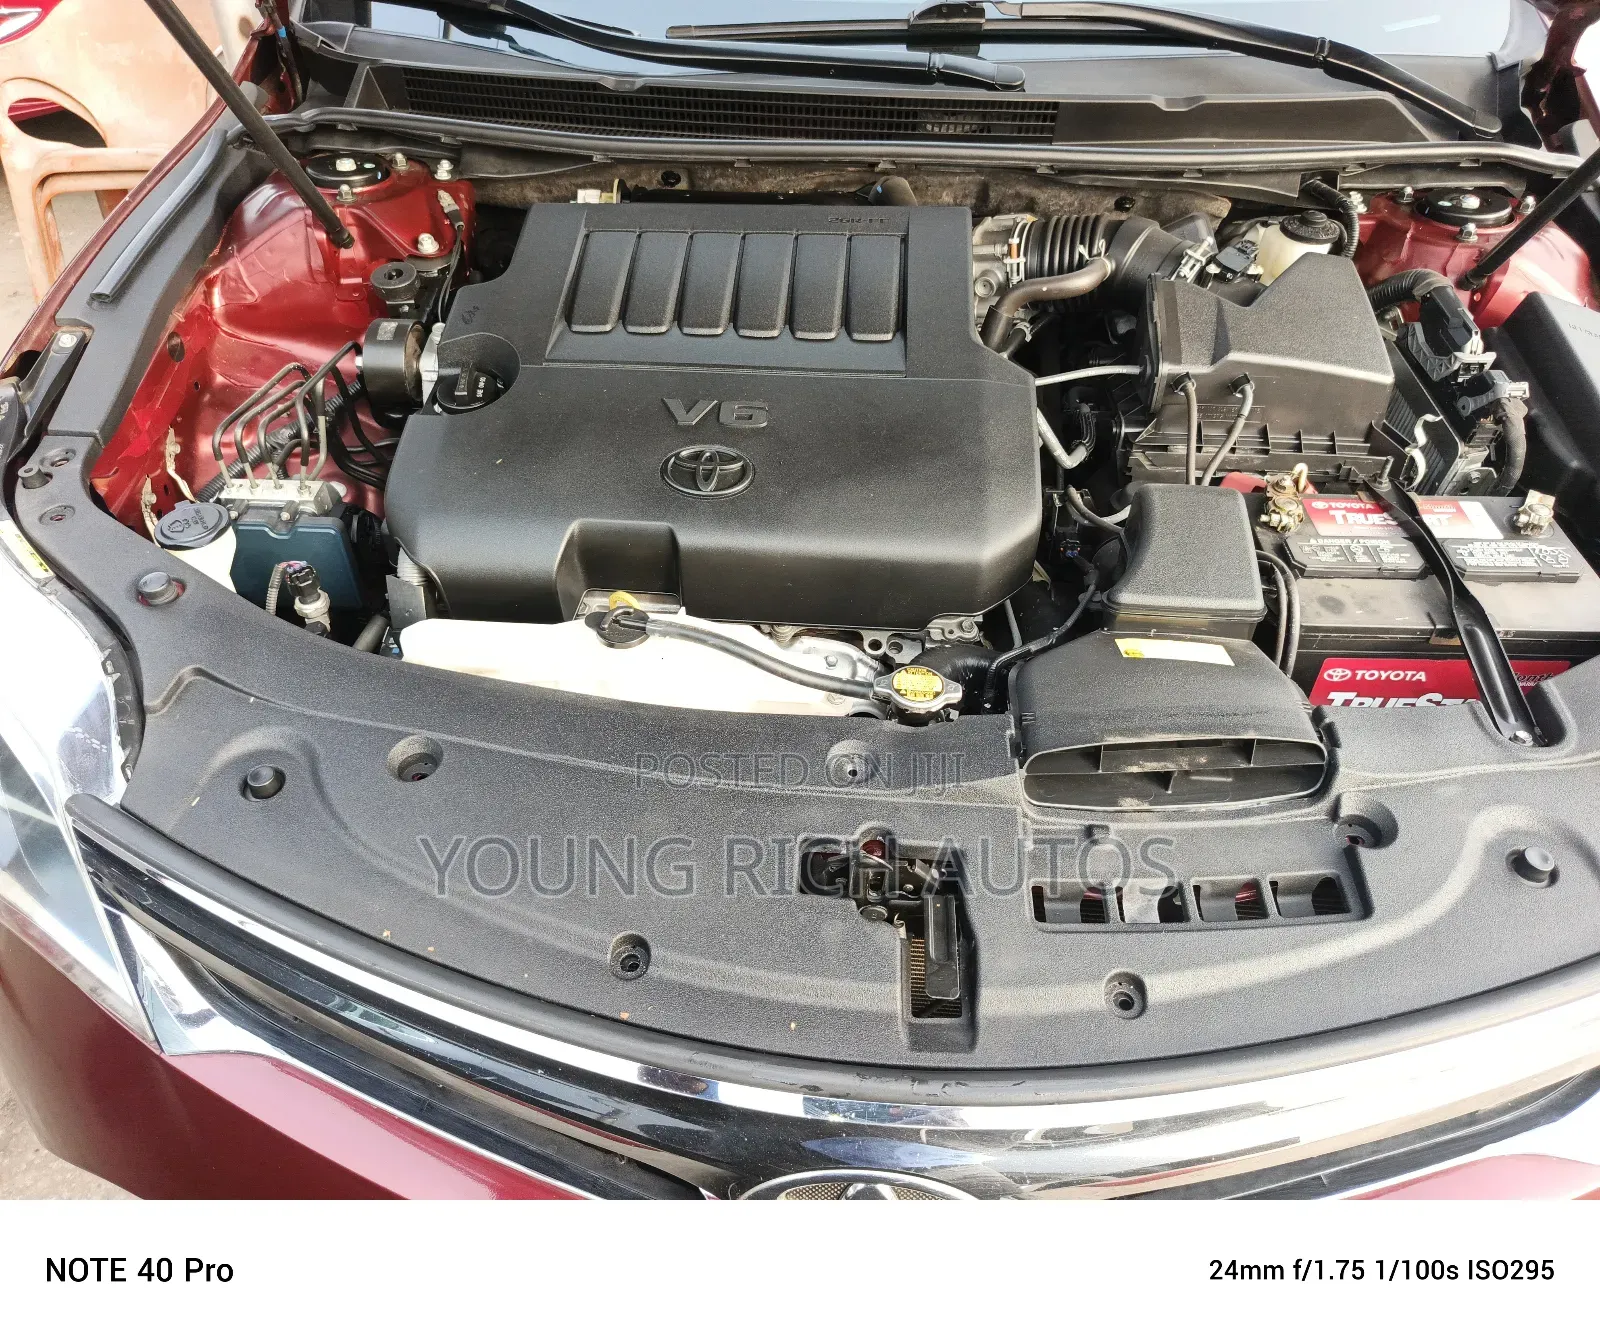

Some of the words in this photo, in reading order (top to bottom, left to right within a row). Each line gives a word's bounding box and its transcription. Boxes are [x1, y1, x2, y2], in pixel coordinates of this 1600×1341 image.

[661, 398, 768, 428] V6
[1328, 501, 1375, 509] TOYOTA
[1355, 670, 1427, 682] TOYOTA
